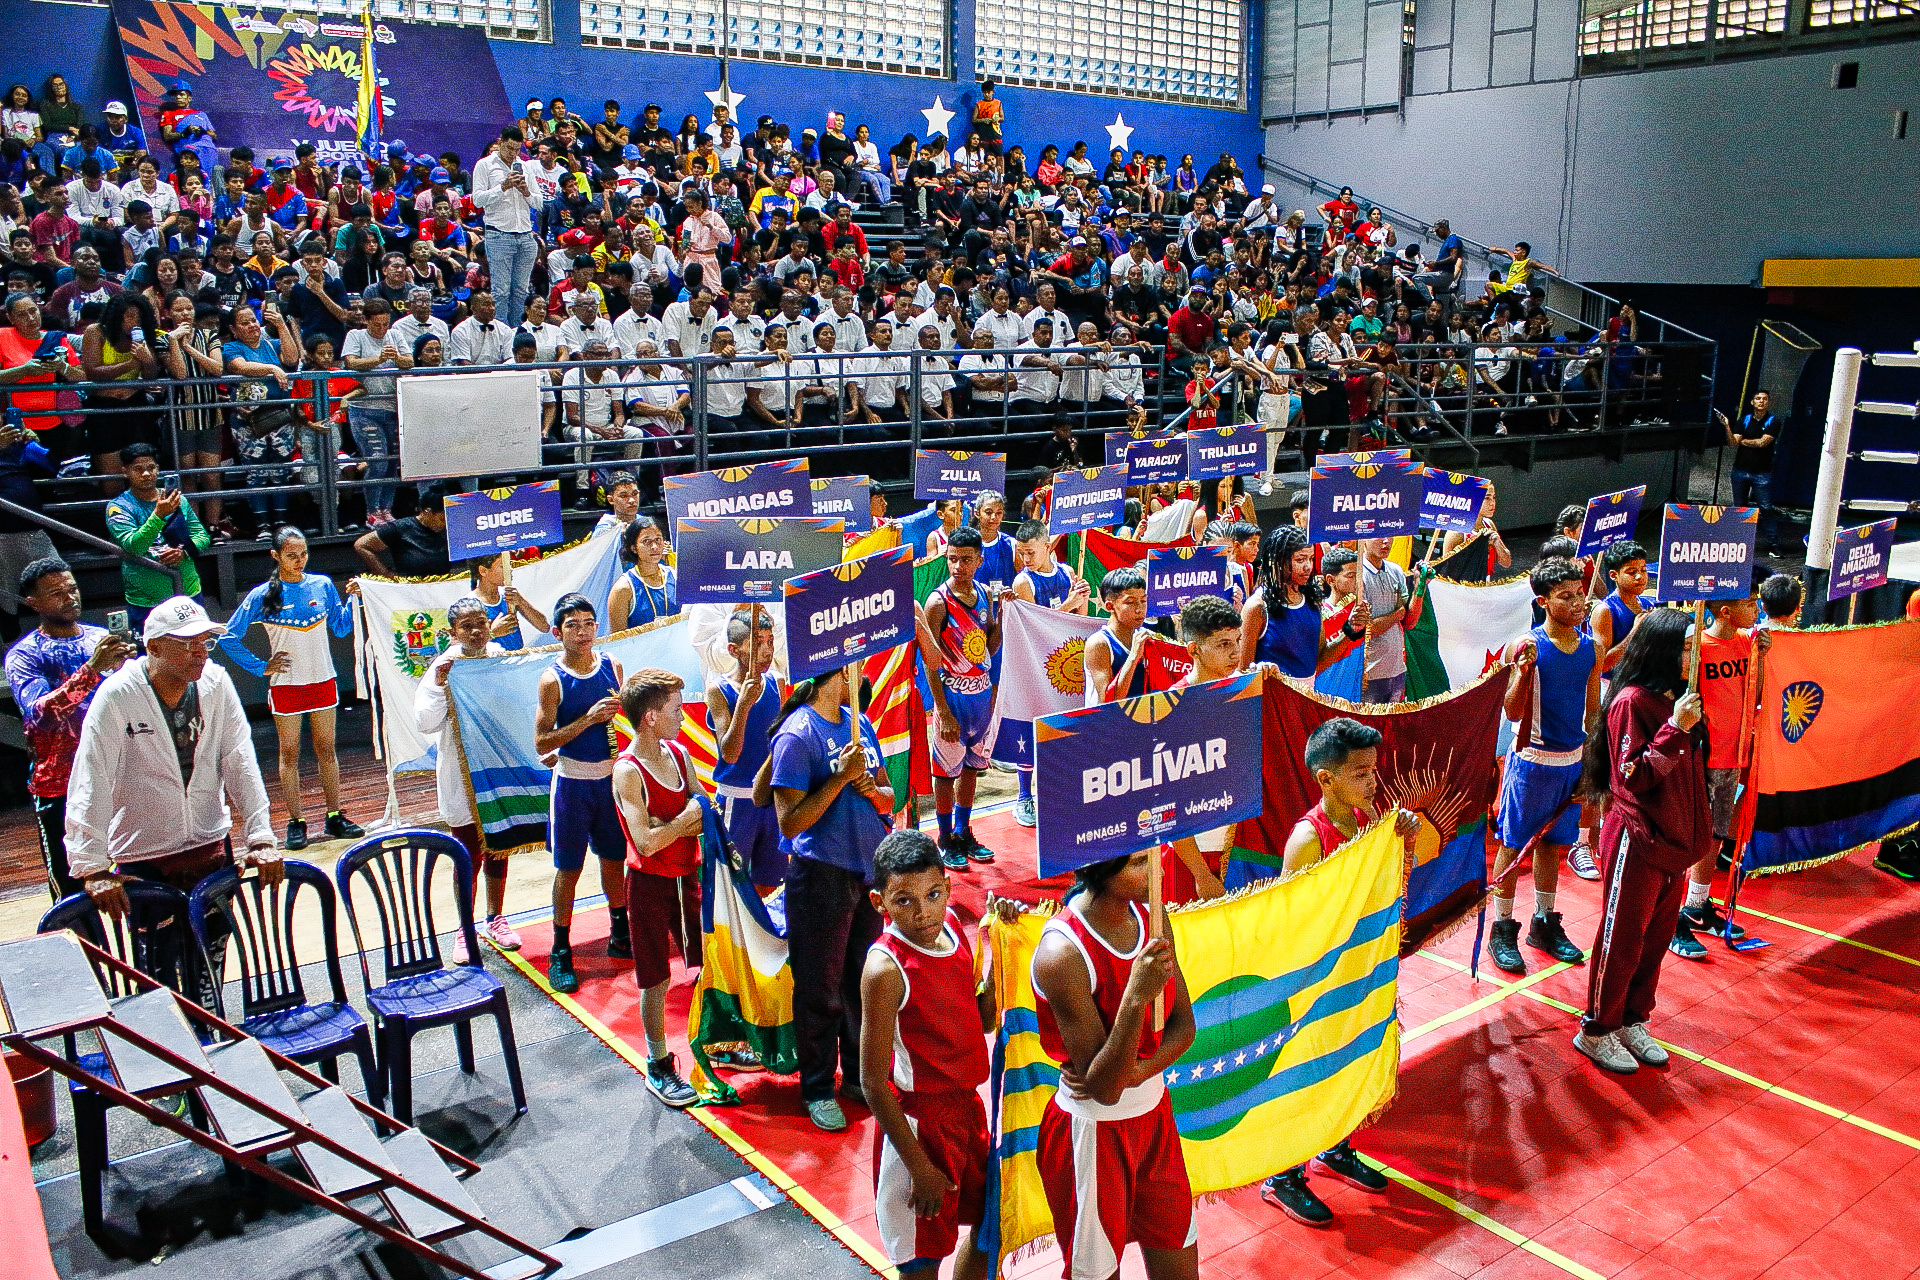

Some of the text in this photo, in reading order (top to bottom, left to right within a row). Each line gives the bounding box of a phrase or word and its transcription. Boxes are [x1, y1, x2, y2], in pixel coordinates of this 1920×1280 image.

[1134, 454, 1182, 468] YARACUY
[1199, 443, 1257, 460] TRUJILLO
[941, 469, 981, 481] ZULIA
[687, 489, 794, 517] MONAGAS
[812, 499, 854, 515] CHIRA
[1055, 488, 1122, 510] PORTUGUESA
[1333, 489, 1400, 513] FALCÓN
[1425, 491, 1472, 511] MIRANDA
[476, 508, 534, 530] SUCRE
[1593, 512, 1628, 532] MÉRIDA
[725, 551, 794, 569] LARA
[1669, 541, 1747, 563] CARABOBO
[1849, 543, 1874, 561] DELTA
[1840, 553, 1881, 576] AMACURO
[1155, 571, 1218, 590] LA GUAIRA
[809, 589, 895, 635] GUÁRICO
[1082, 738, 1227, 804] BOLÍVAR
[1076, 822, 1127, 845] MONAGAS
